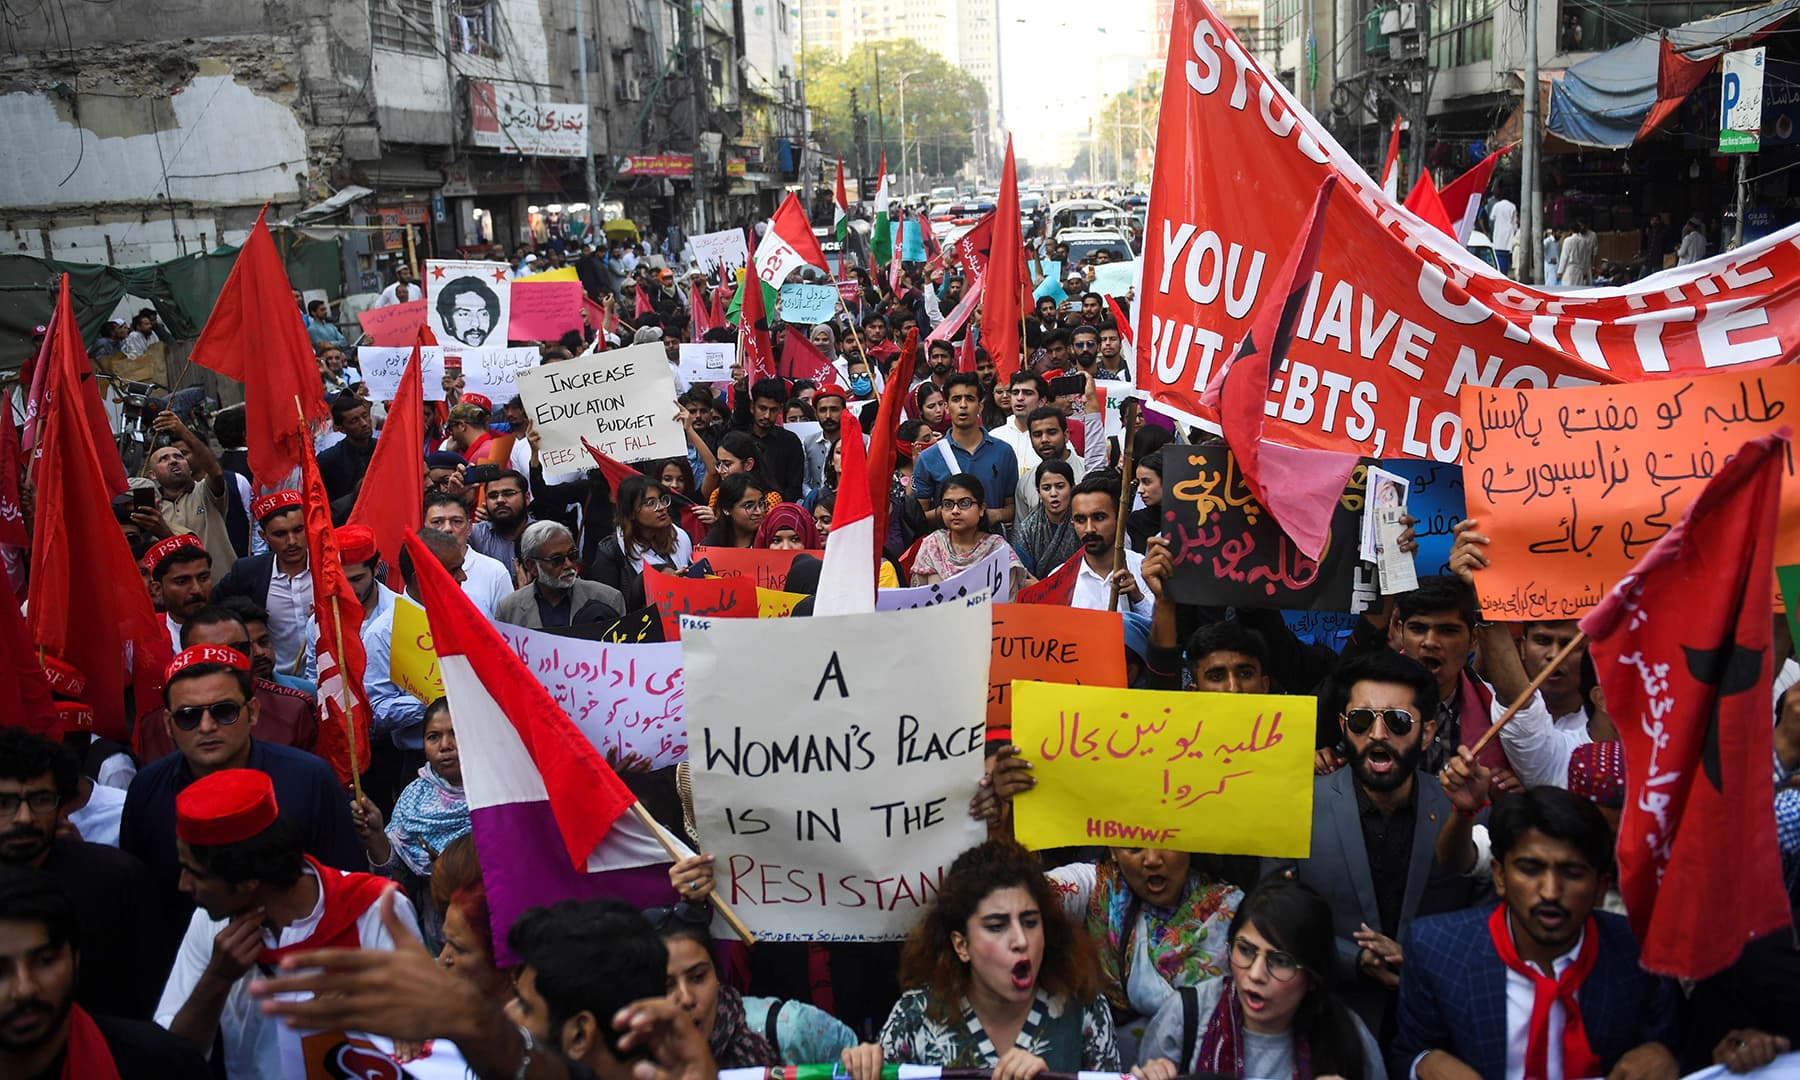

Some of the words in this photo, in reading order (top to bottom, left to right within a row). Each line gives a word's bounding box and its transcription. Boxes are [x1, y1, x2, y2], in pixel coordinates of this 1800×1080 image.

[1722, 72, 1741, 130] P
[1159, 219, 1267, 319] YOU
[544, 363, 635, 394] INCREASE
[535, 394, 626, 426] EDUCATION
[596, 413, 656, 434] BUDGET
[1655, 382, 1694, 430] کو
[1703, 377, 1785, 432] طلبہ
[541, 448, 576, 468] FEES
[624, 434, 657, 451] FALL
[258, 496, 277, 515] PSF
[158, 537, 184, 558] PSF
[681, 617, 712, 631] PRSF
[203, 648, 239, 664] PSF
[812, 650, 850, 701] A
[703, 725, 876, 778] WOMAN'S
[896, 714, 986, 767] PLACE
[1039, 710, 1101, 762] بحال
[1213, 710, 1285, 765] طلبہ
[725, 807, 771, 835] IS
[796, 807, 842, 843] IN
[870, 797, 947, 838] THE
[1085, 817, 1182, 844] HBWWF
